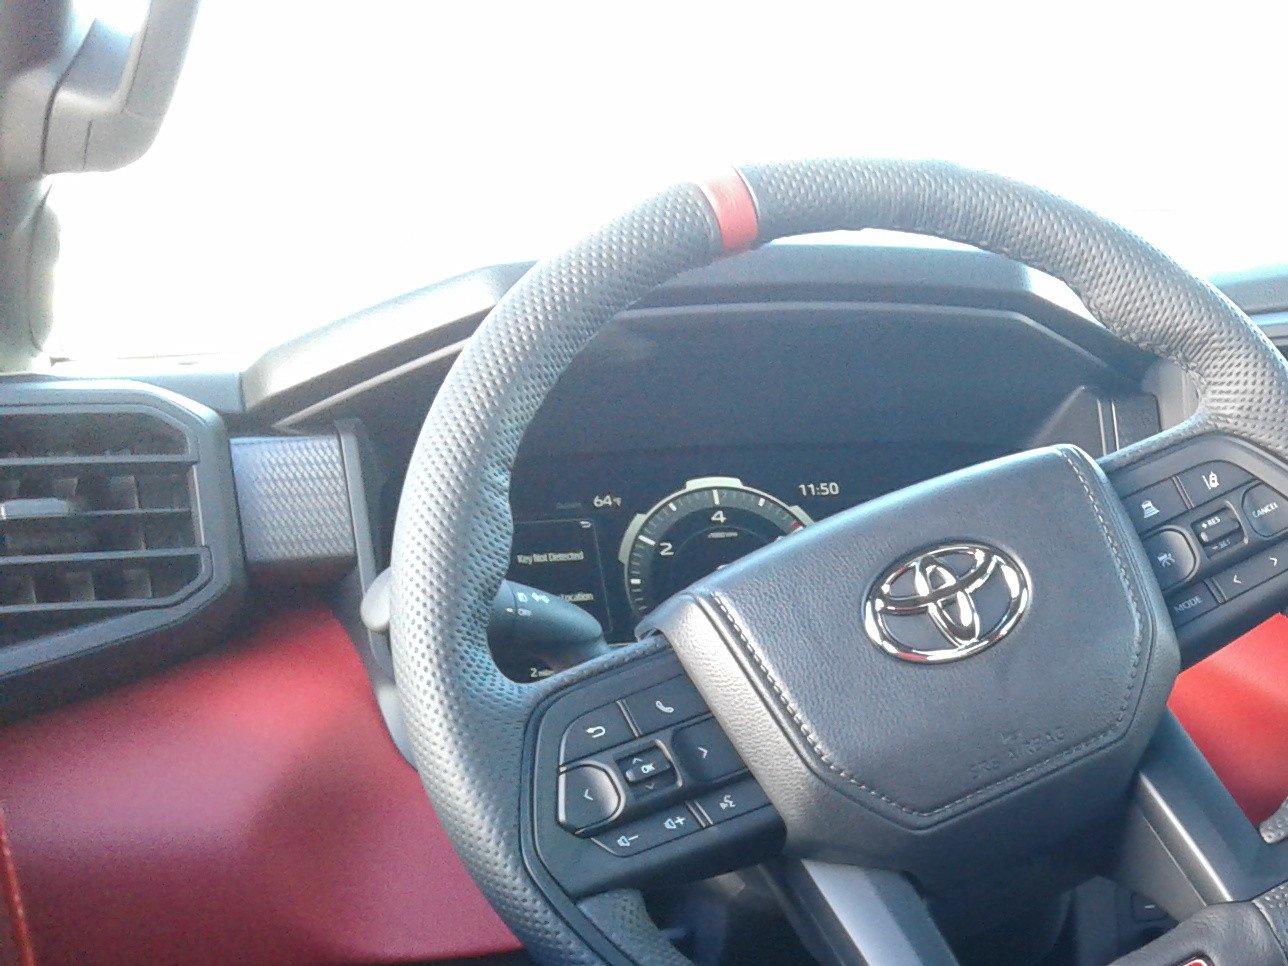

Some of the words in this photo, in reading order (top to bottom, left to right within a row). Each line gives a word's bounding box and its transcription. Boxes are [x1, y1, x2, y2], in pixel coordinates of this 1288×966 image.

[799, 482, 840, 496] 11:50
[711, 511, 727, 523] 4
[1252, 502, 1278, 518] CANCEL
[659, 542, 674, 556] 2
